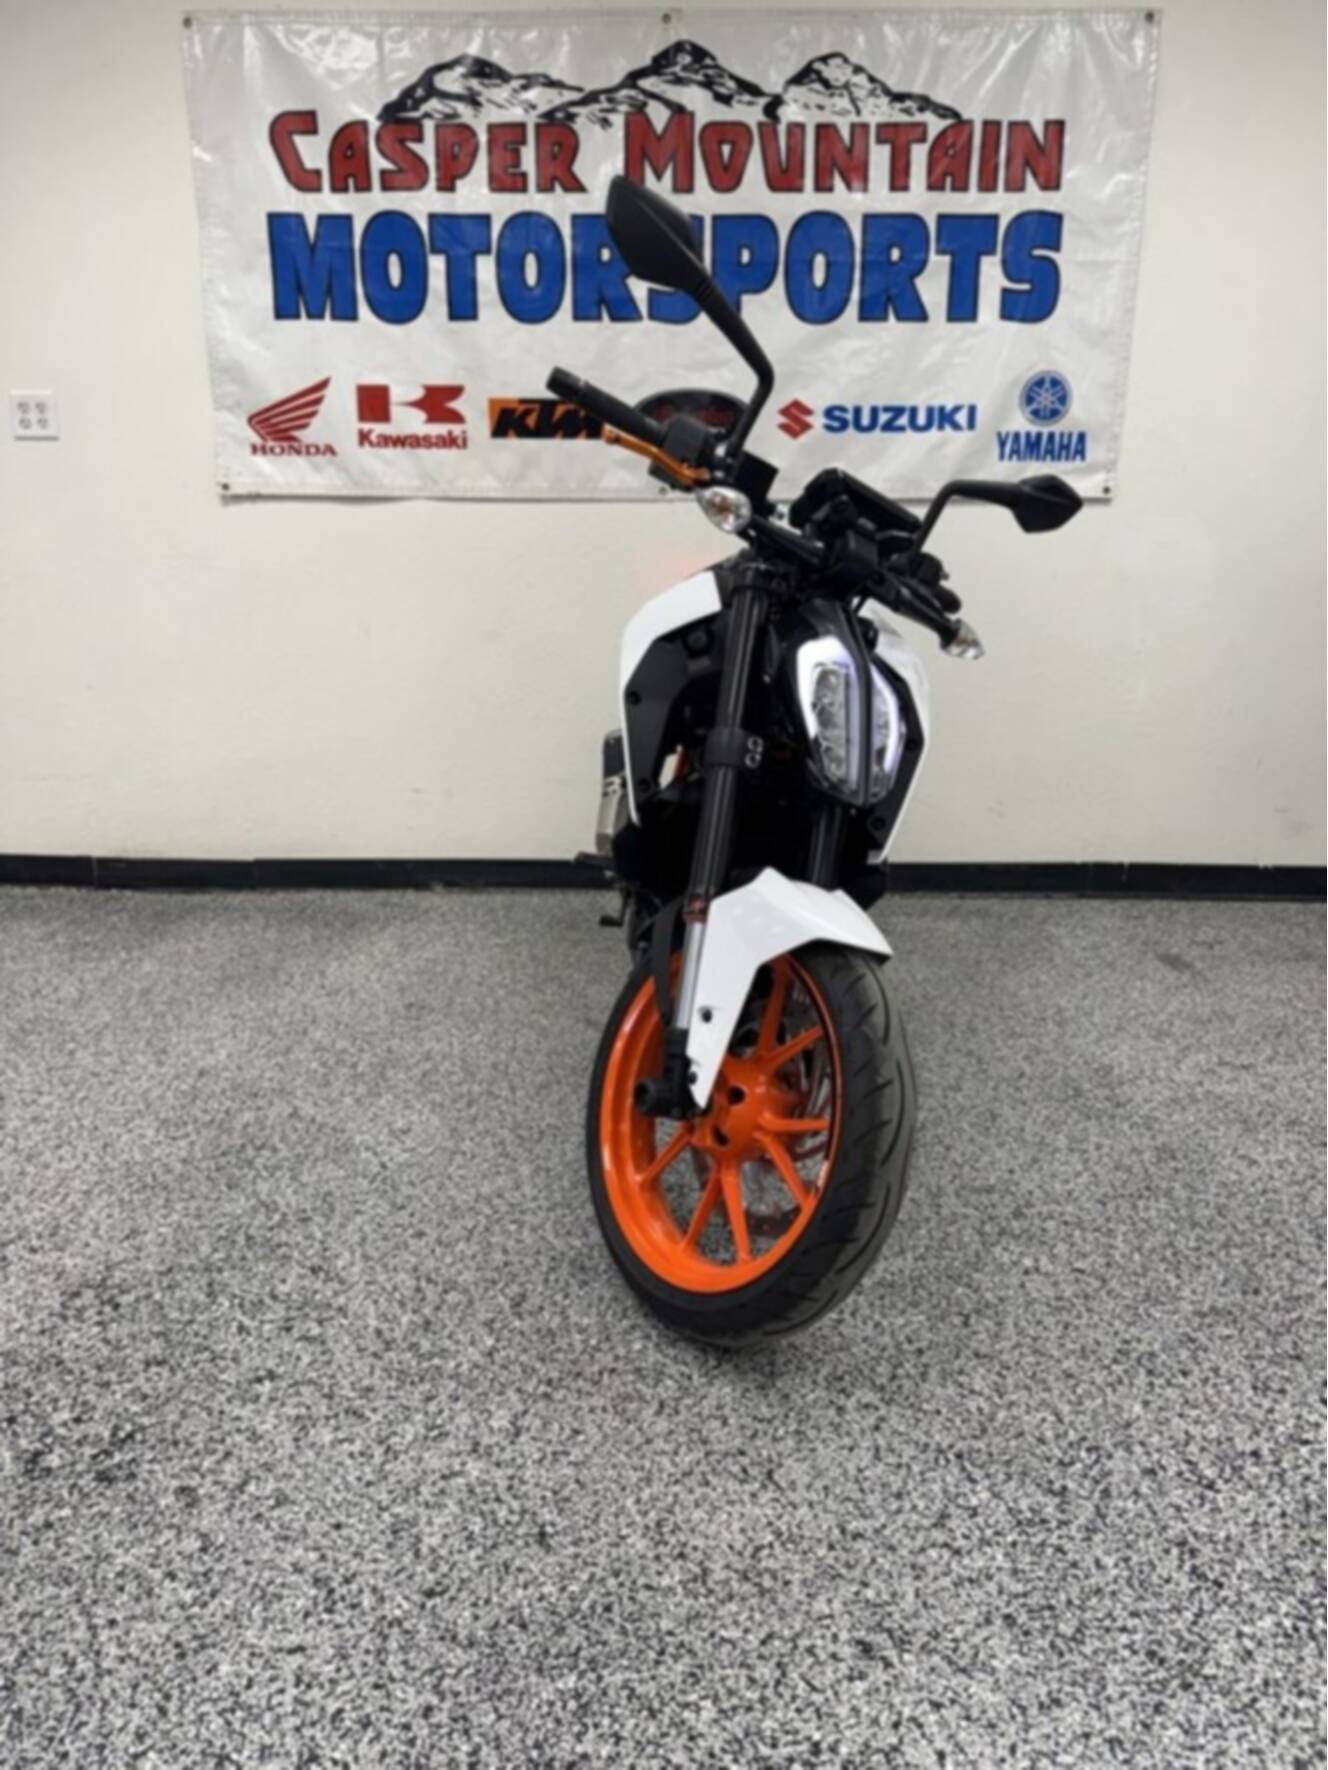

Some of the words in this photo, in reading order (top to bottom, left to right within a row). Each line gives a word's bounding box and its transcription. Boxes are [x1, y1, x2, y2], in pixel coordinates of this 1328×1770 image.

[268, 109, 588, 194] CASPER
[623, 110, 1066, 194] MOUNTAIN
[822, 404, 978, 434] SUZUKI
[250, 442, 338, 457] HONDA
[357, 428, 469, 450] Kawasaki
[996, 430, 1087, 463] YAMAHA
